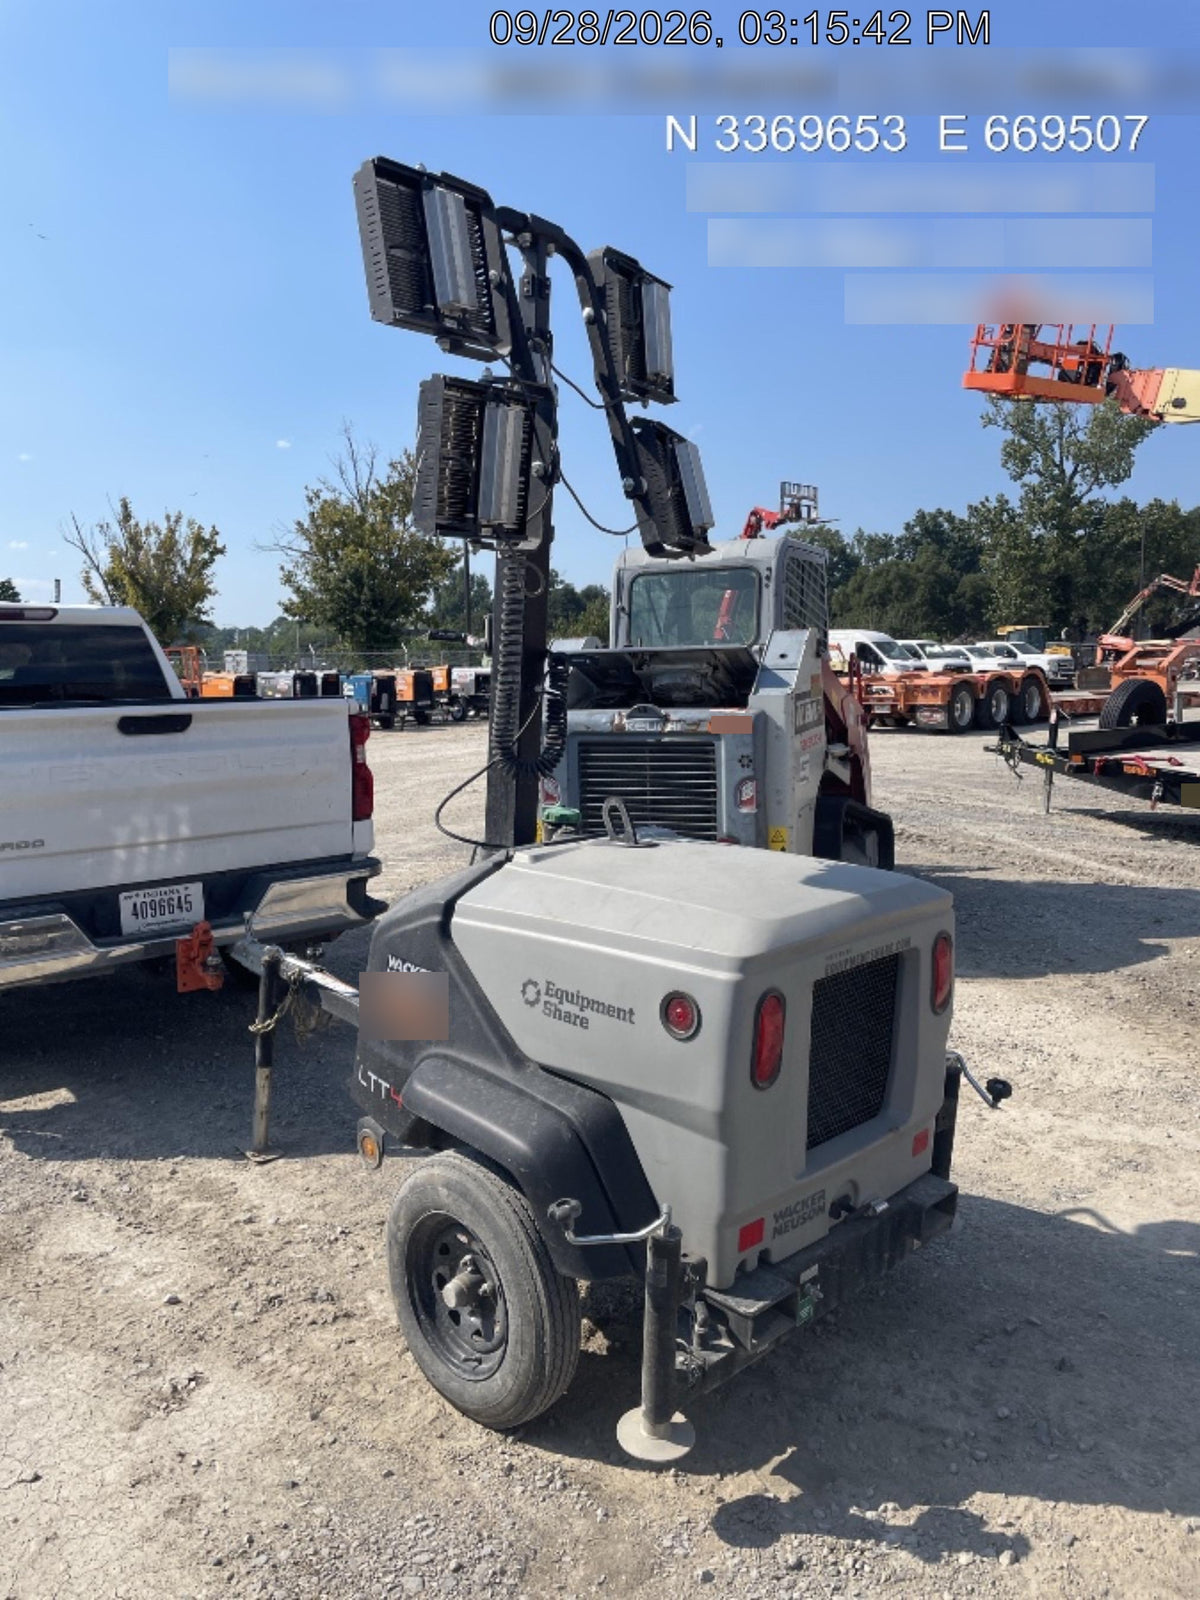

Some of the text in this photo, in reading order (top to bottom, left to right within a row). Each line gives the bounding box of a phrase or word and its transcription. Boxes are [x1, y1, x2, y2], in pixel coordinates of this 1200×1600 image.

[131, 893, 193, 920] 4096645
[542, 1000, 590, 1030] Share
[544, 979, 636, 1025] Equipment
[772, 1201, 826, 1240] NEUSON
[773, 1189, 826, 1225] WACKER
